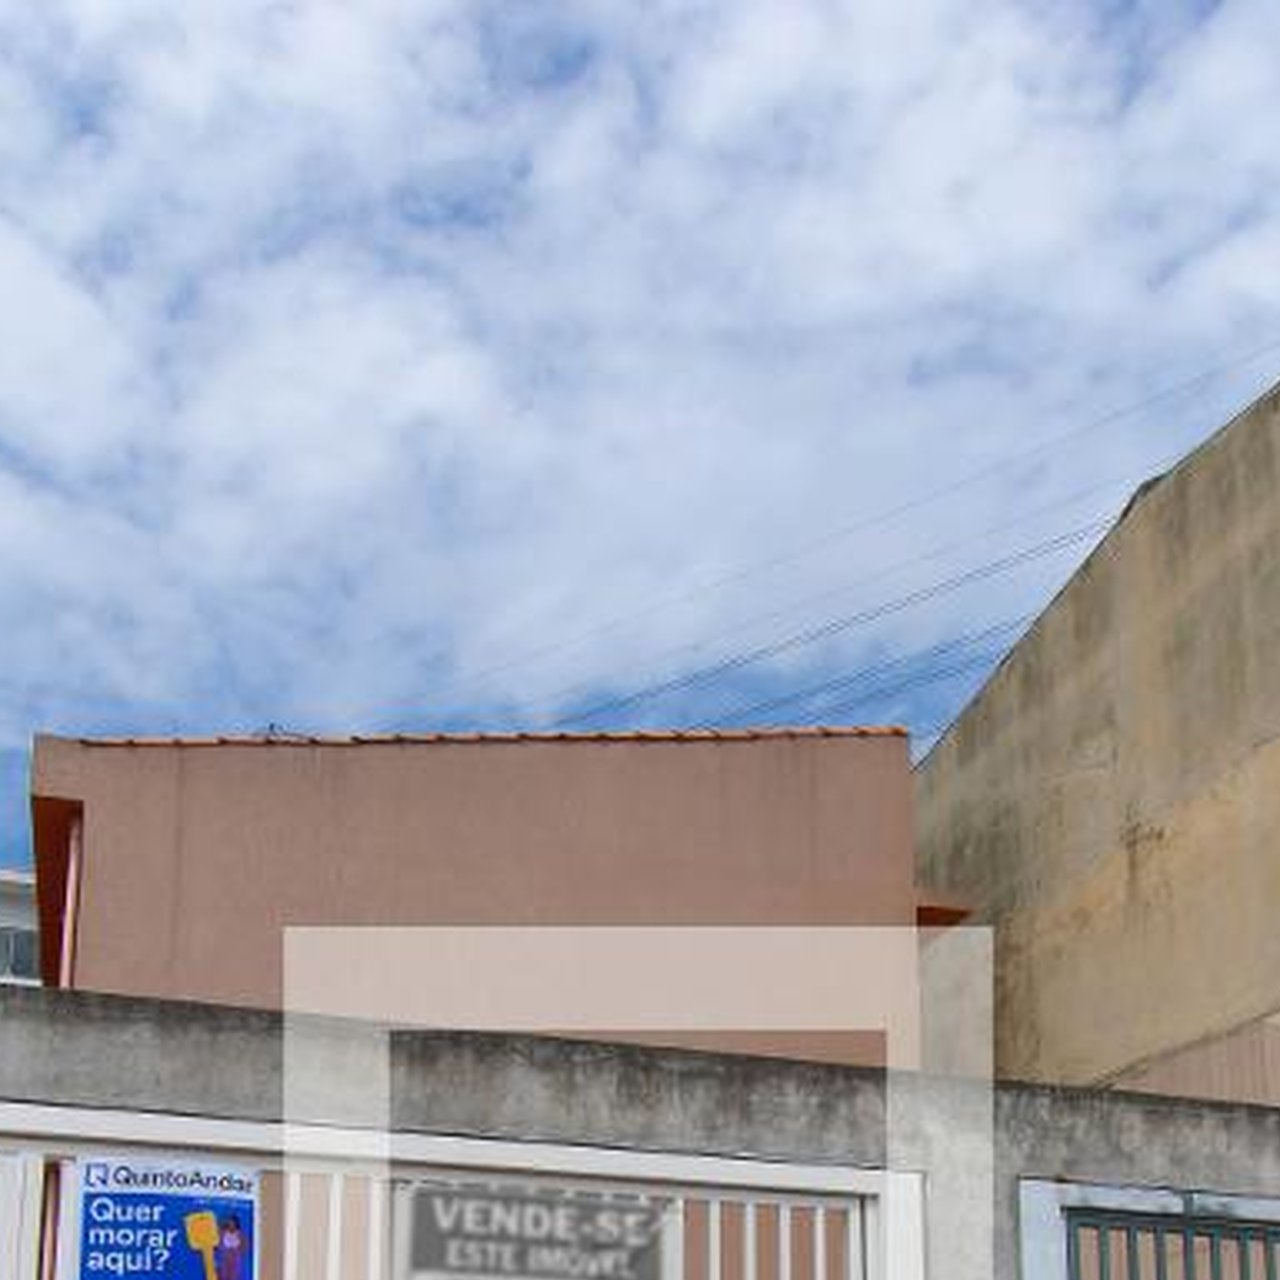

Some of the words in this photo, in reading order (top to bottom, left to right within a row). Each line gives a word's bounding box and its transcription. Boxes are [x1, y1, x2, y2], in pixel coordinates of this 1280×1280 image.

[113, 1165, 253, 1192] QuintoAndar
[90, 1197, 165, 1222] Quer
[88, 1227, 178, 1247] morar
[87, 1248, 170, 1276] aqui?
